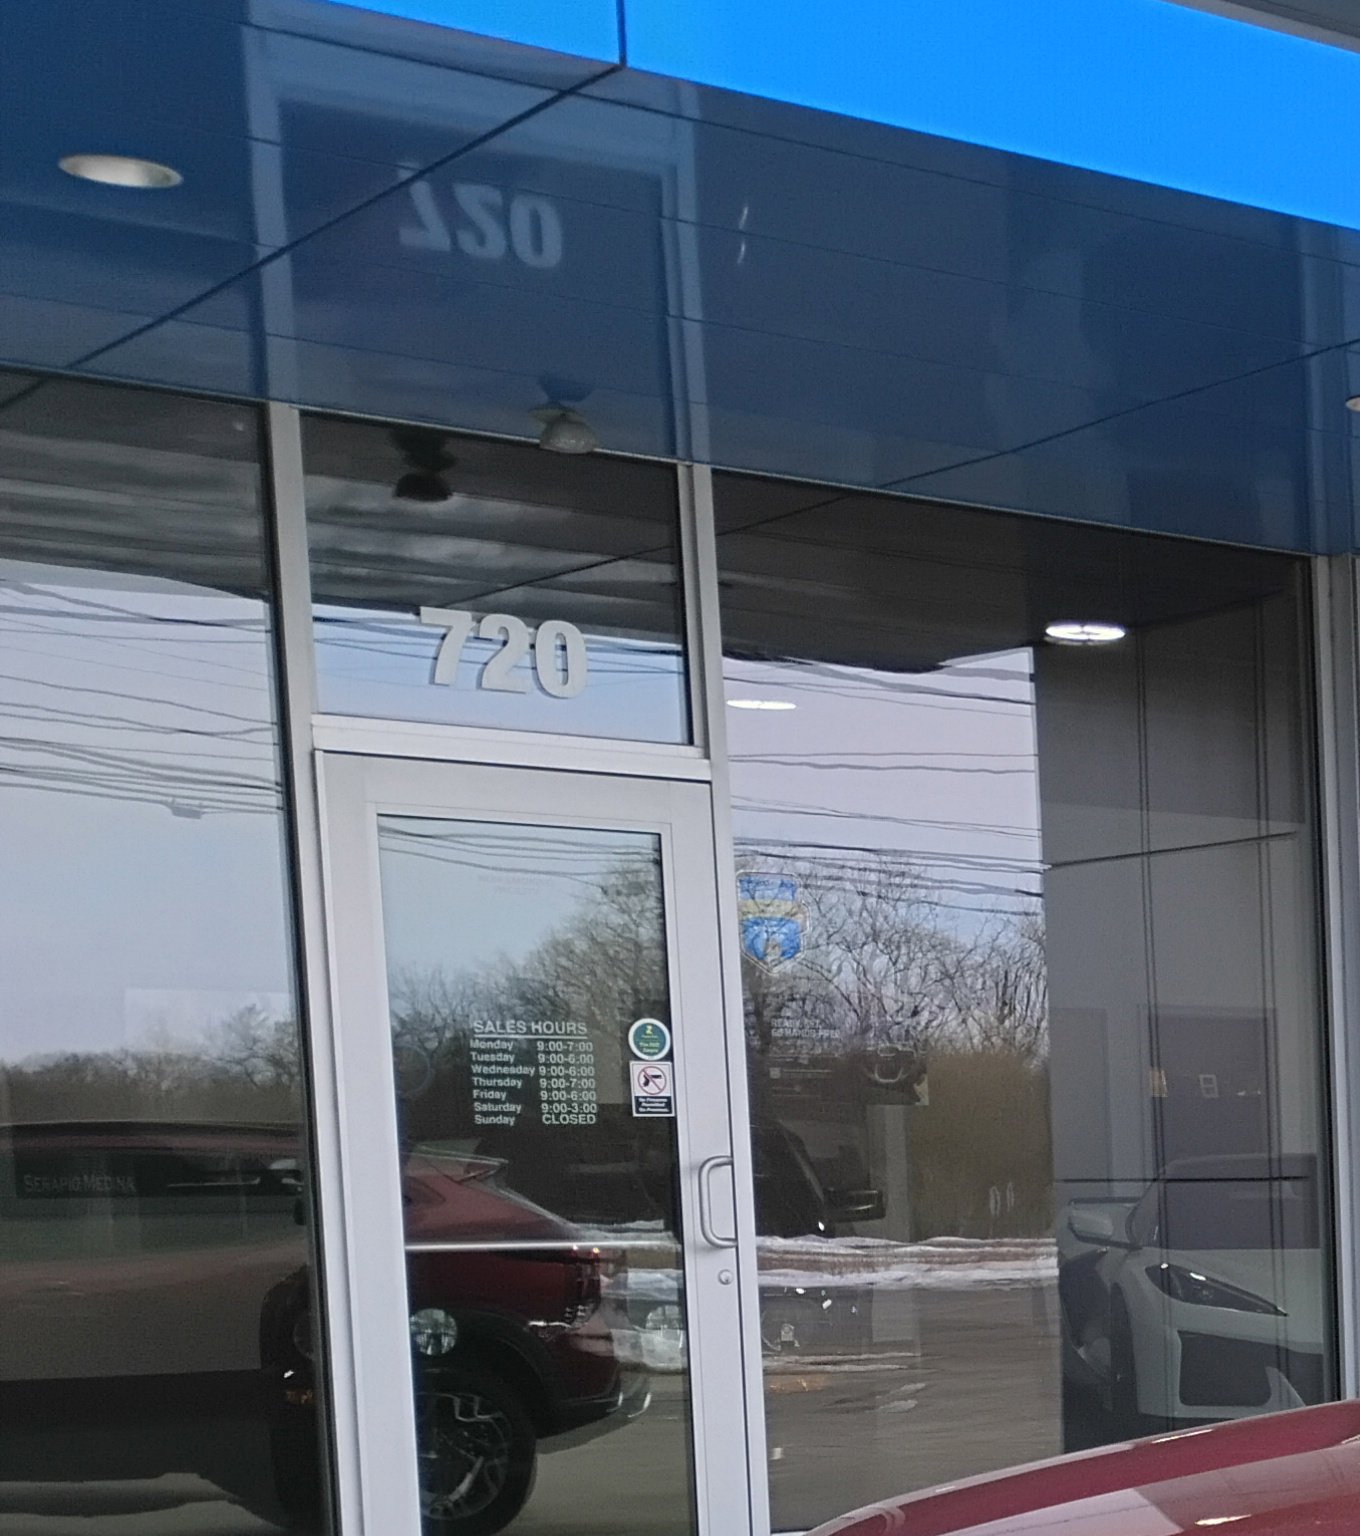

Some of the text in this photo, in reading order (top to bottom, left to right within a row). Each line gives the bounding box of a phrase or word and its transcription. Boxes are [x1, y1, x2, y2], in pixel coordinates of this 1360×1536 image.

[420, 606, 588, 699] 720
[473, 1020, 588, 1034] SALES HOURS
[470, 1039, 593, 1051] Monday 9:00-7:00
[470, 1052, 594, 1064] Tuesday 9:00-6:00
[471, 1065, 595, 1077] Wednesday 9:00-6:00
[472, 1077, 596, 1089] Thursday 9:00-7:00
[473, 1089, 597, 1101] Friday 9:00-6:00
[474, 1102, 598, 1114] Saturday 9:00-3:00
[474, 1114, 597, 1126] Sunday CLOSED
